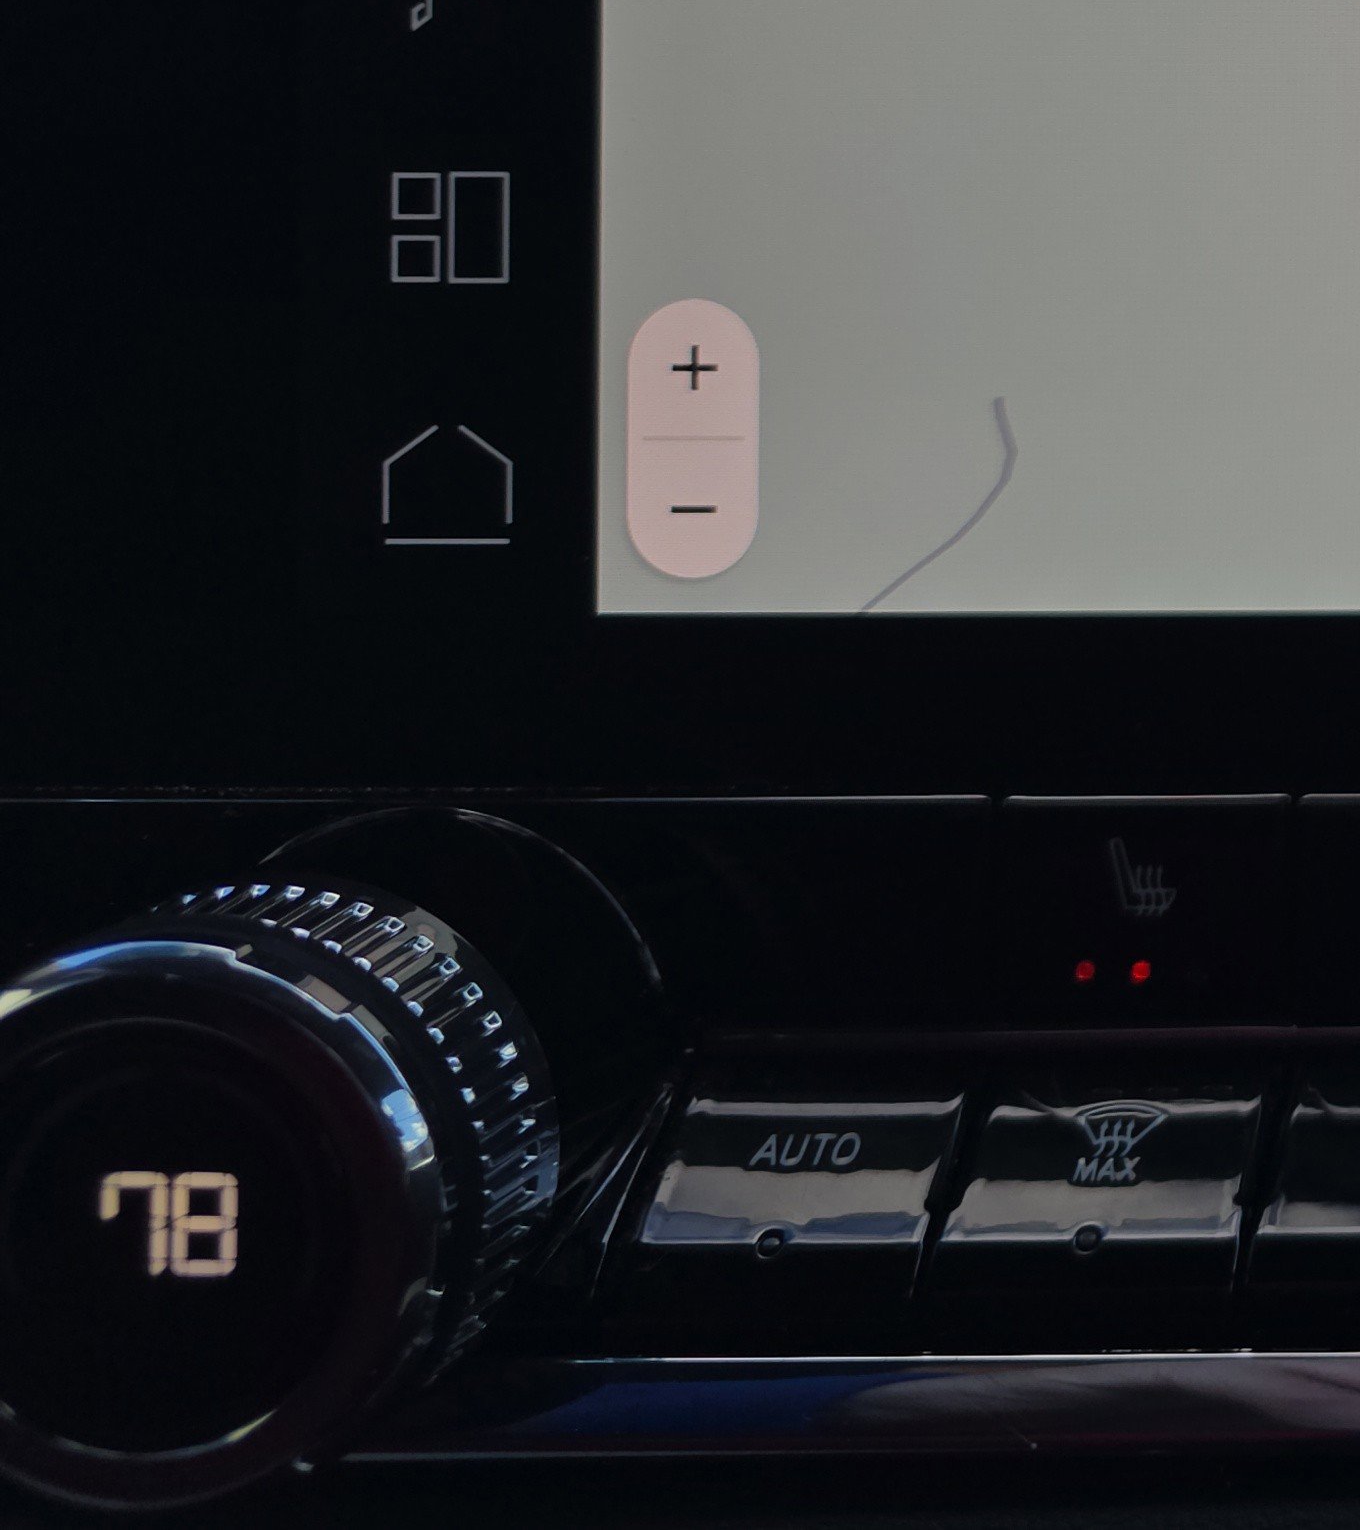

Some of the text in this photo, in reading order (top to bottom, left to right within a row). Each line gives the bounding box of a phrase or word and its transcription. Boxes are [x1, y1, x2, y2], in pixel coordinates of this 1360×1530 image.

[749, 1132, 862, 1168] AUTO
[1073, 1157, 1142, 1184] MAX
[100, 1170, 239, 1277] 78
